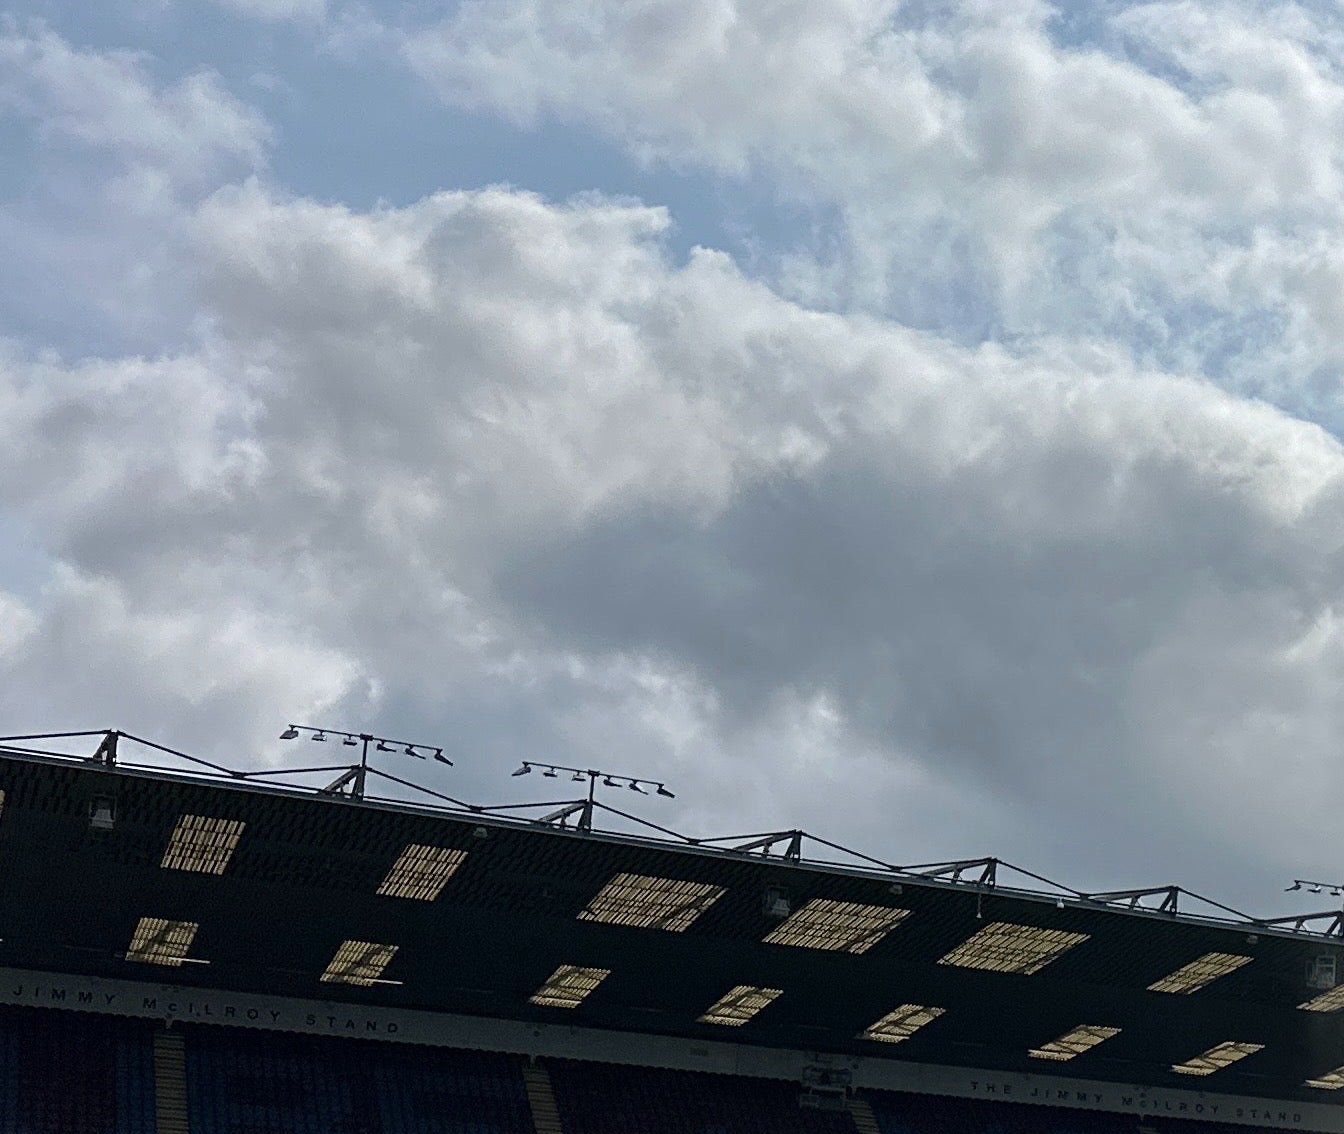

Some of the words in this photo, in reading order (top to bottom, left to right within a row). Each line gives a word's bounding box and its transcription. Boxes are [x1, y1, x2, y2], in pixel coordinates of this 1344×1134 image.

[13, 986, 116, 1005] JIMMY
[143, 997, 280, 1021] McILROY
[306, 1014, 398, 1033] STAND
[971, 1081, 1011, 1095] THE
[1031, 1088, 1102, 1103] JIMMY
[1237, 1107, 1301, 1122] STAND
